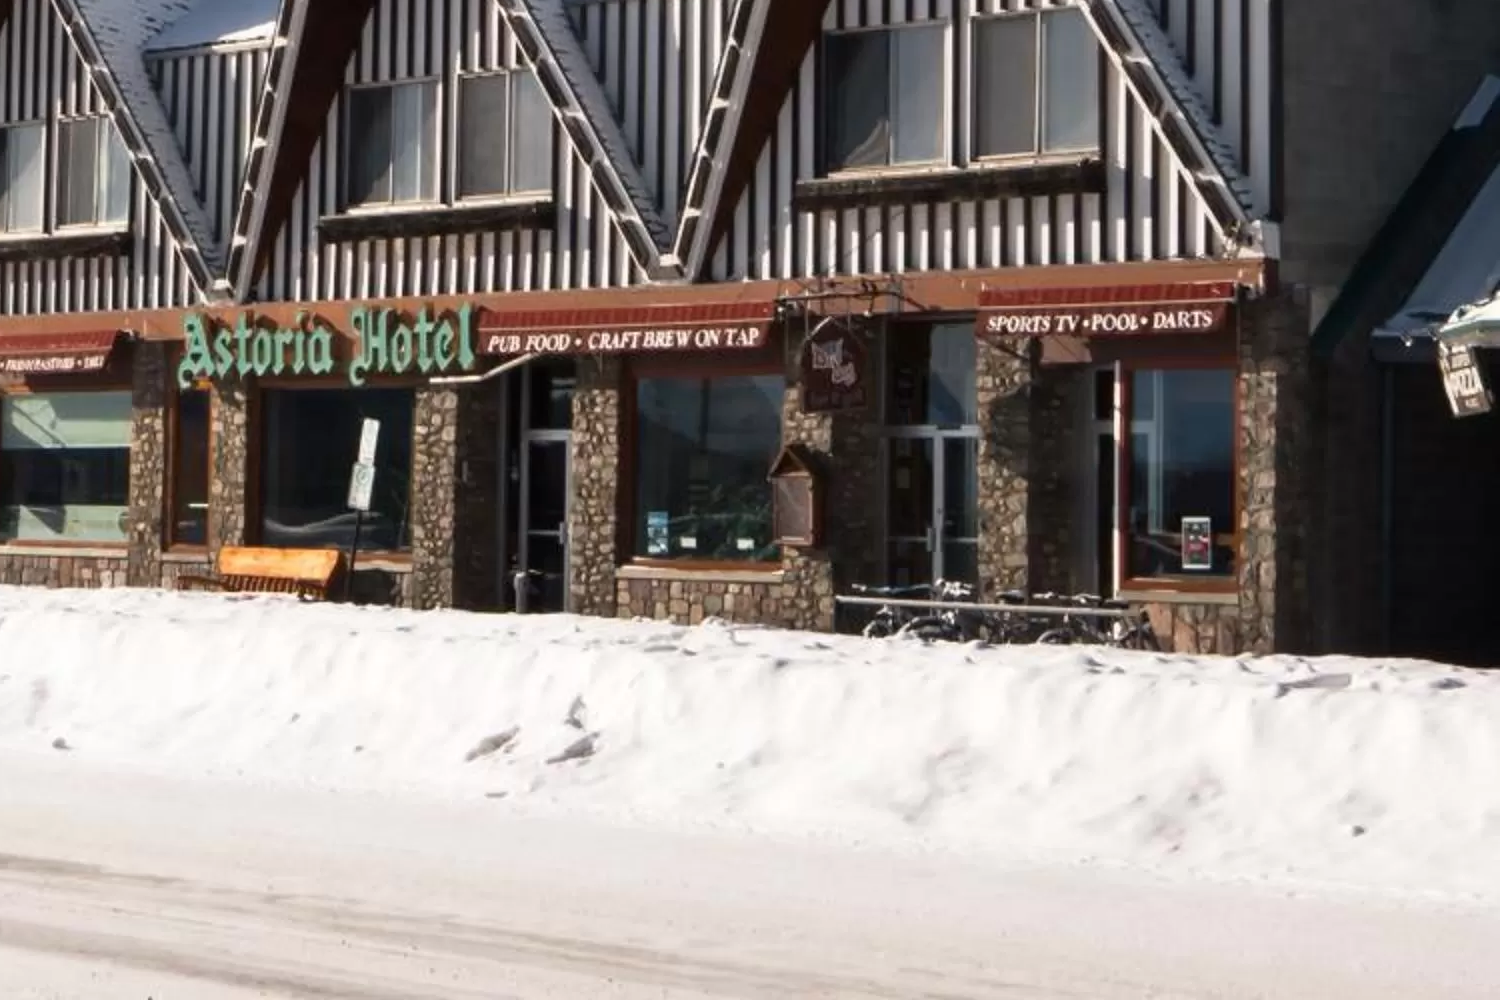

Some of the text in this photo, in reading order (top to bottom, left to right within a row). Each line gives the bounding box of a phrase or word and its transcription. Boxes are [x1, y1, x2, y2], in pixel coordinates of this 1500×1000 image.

[985, 310, 1213, 333] SPORTS TV POOL DARTS
[178, 301, 476, 389] Astoria Hotel
[488, 327, 760, 352] PUB FOOD CRAFT BREW ON TAP
